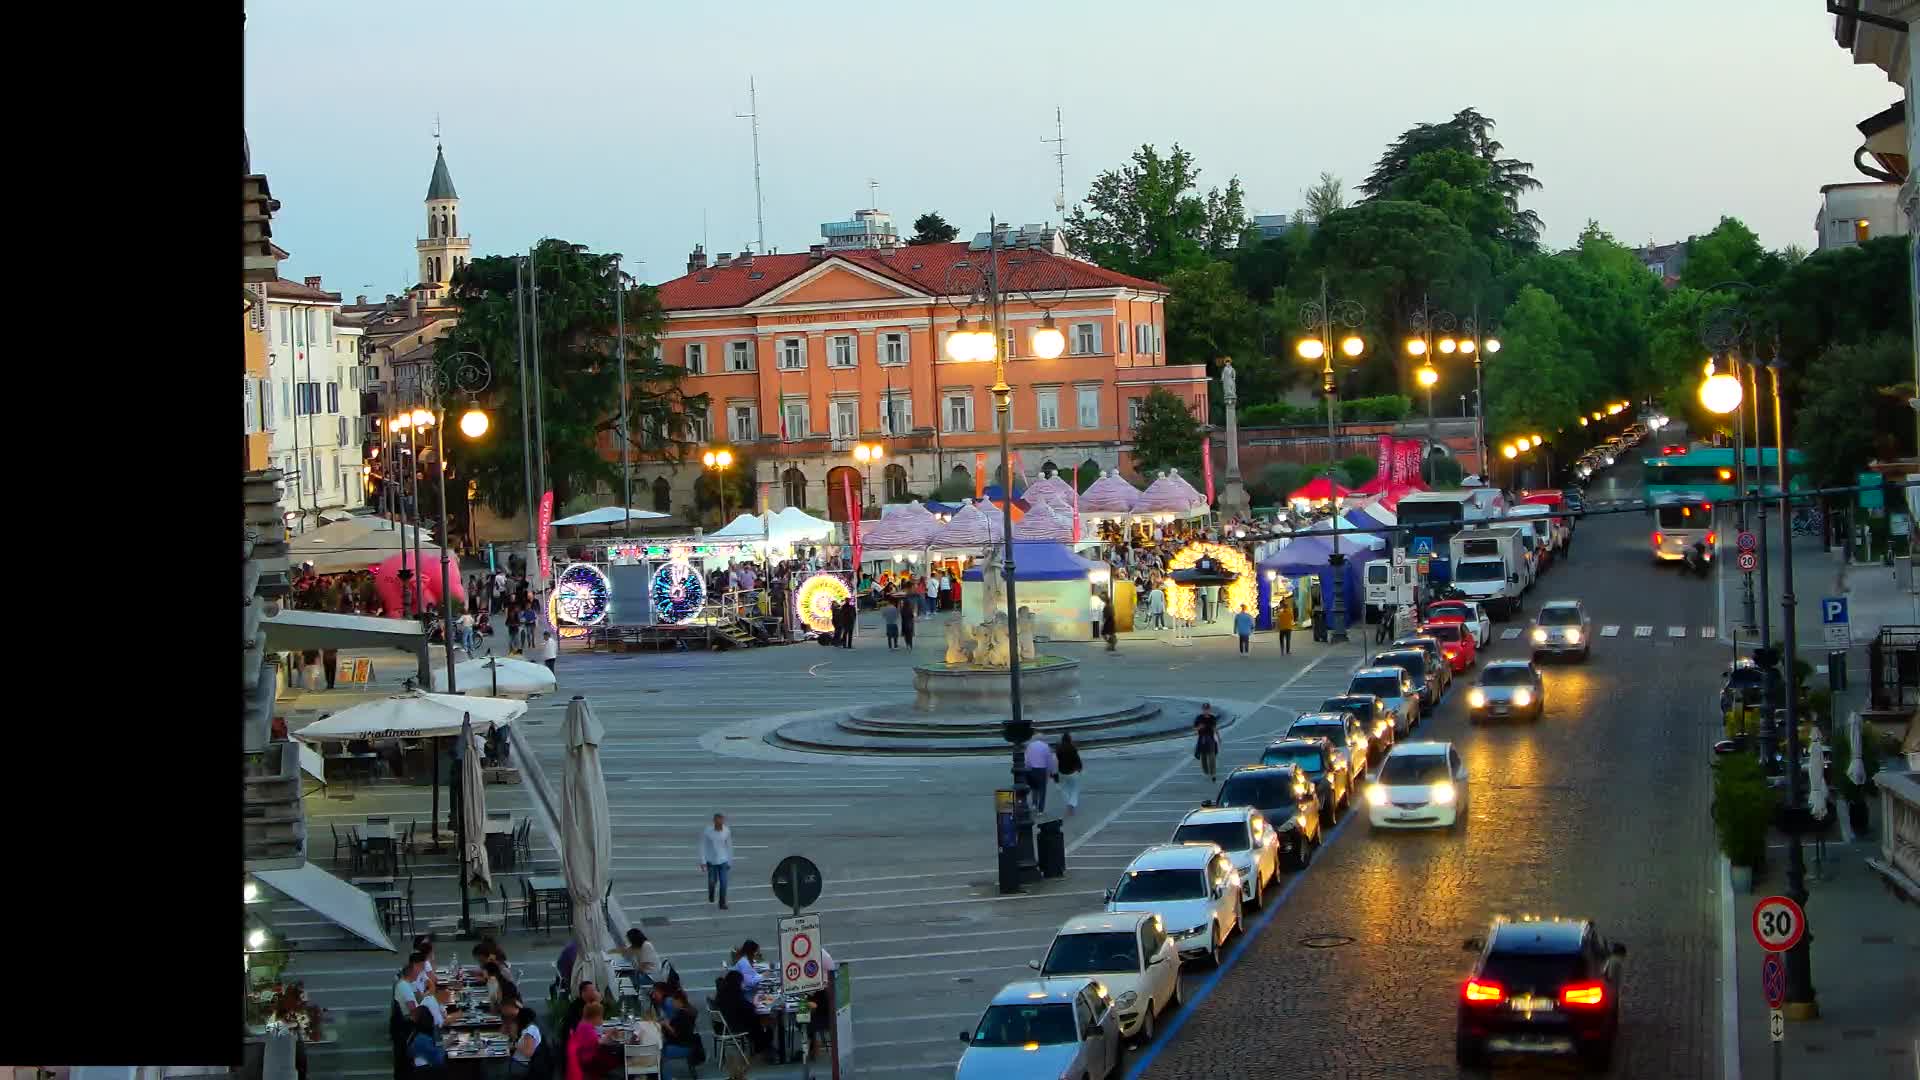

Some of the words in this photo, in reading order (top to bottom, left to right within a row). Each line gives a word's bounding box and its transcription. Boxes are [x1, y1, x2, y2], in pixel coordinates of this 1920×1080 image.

[1743, 557, 1753, 566] 20
[1827, 601, 1842, 621] P
[1762, 911, 1792, 937] 30
